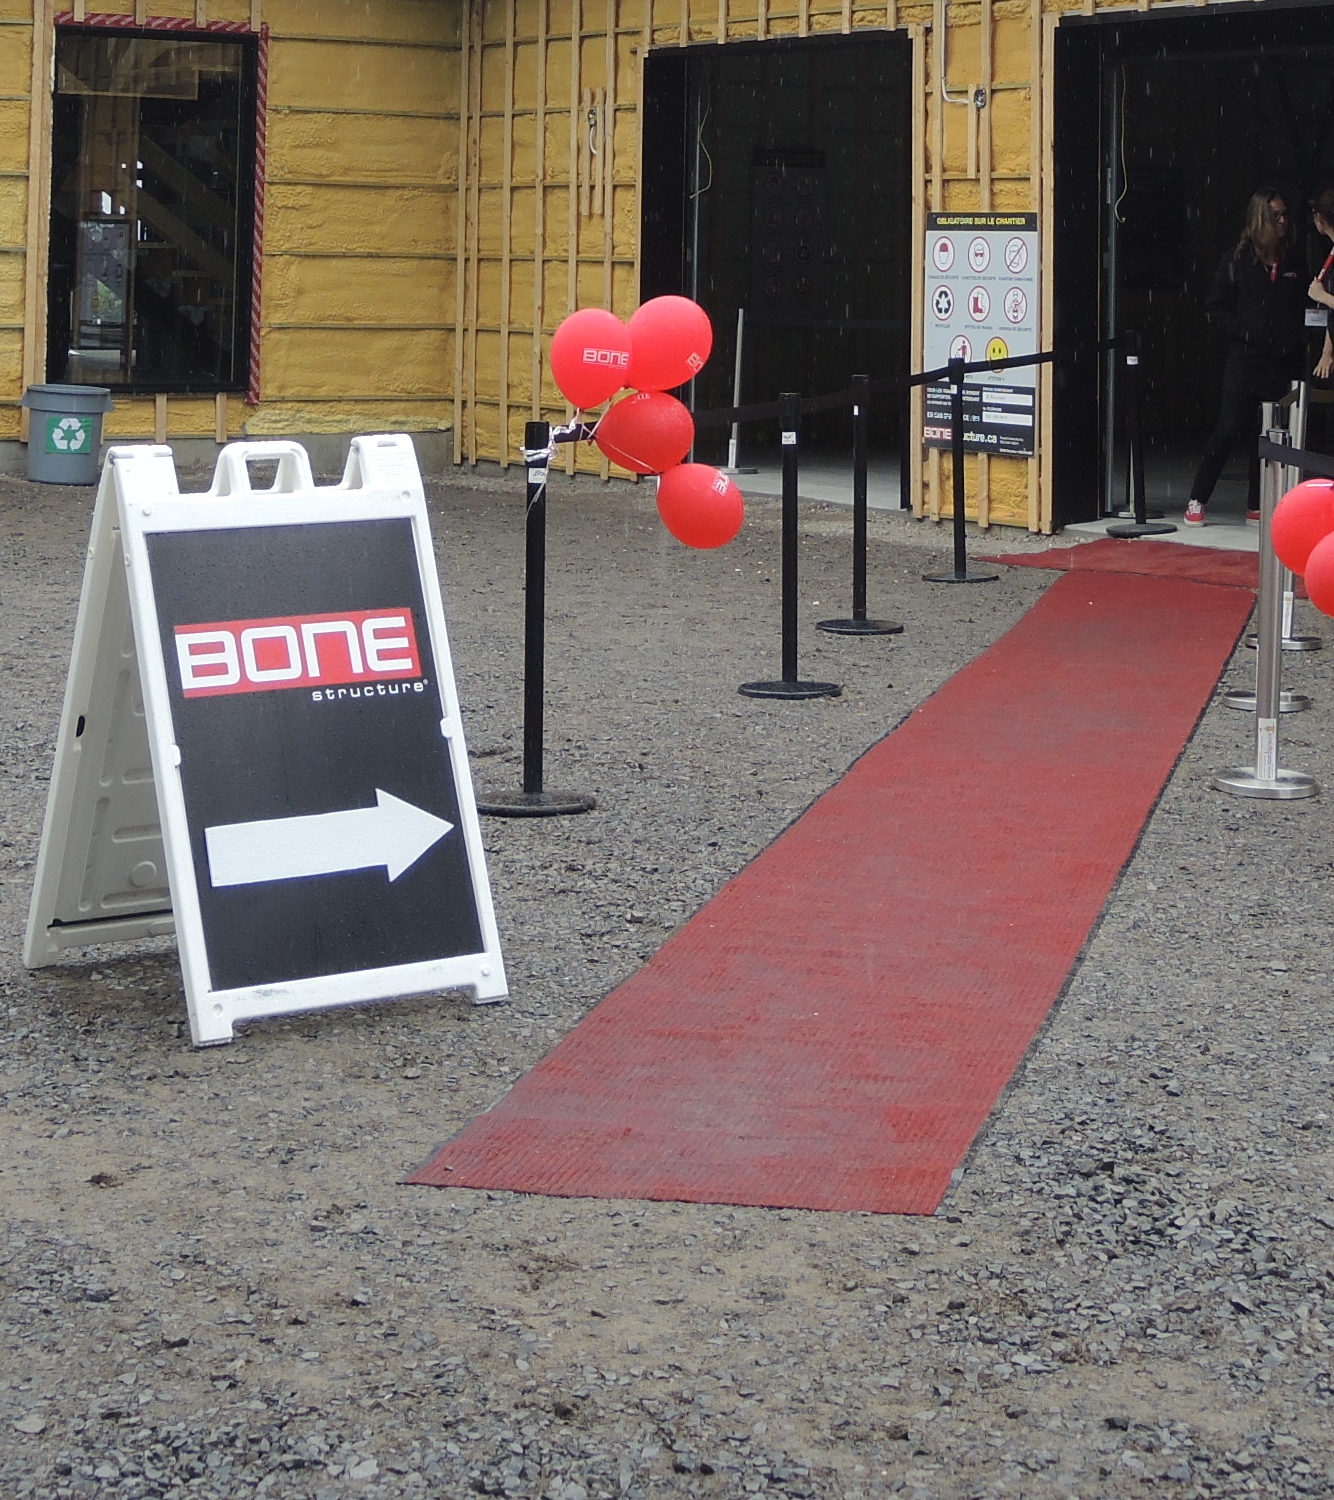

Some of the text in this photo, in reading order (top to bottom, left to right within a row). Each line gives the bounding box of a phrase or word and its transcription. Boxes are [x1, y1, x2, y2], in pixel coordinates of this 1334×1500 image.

[584, 349, 629, 366] BONE
[924, 426, 952, 439] BONE
[174, 616, 413, 690] BONE
